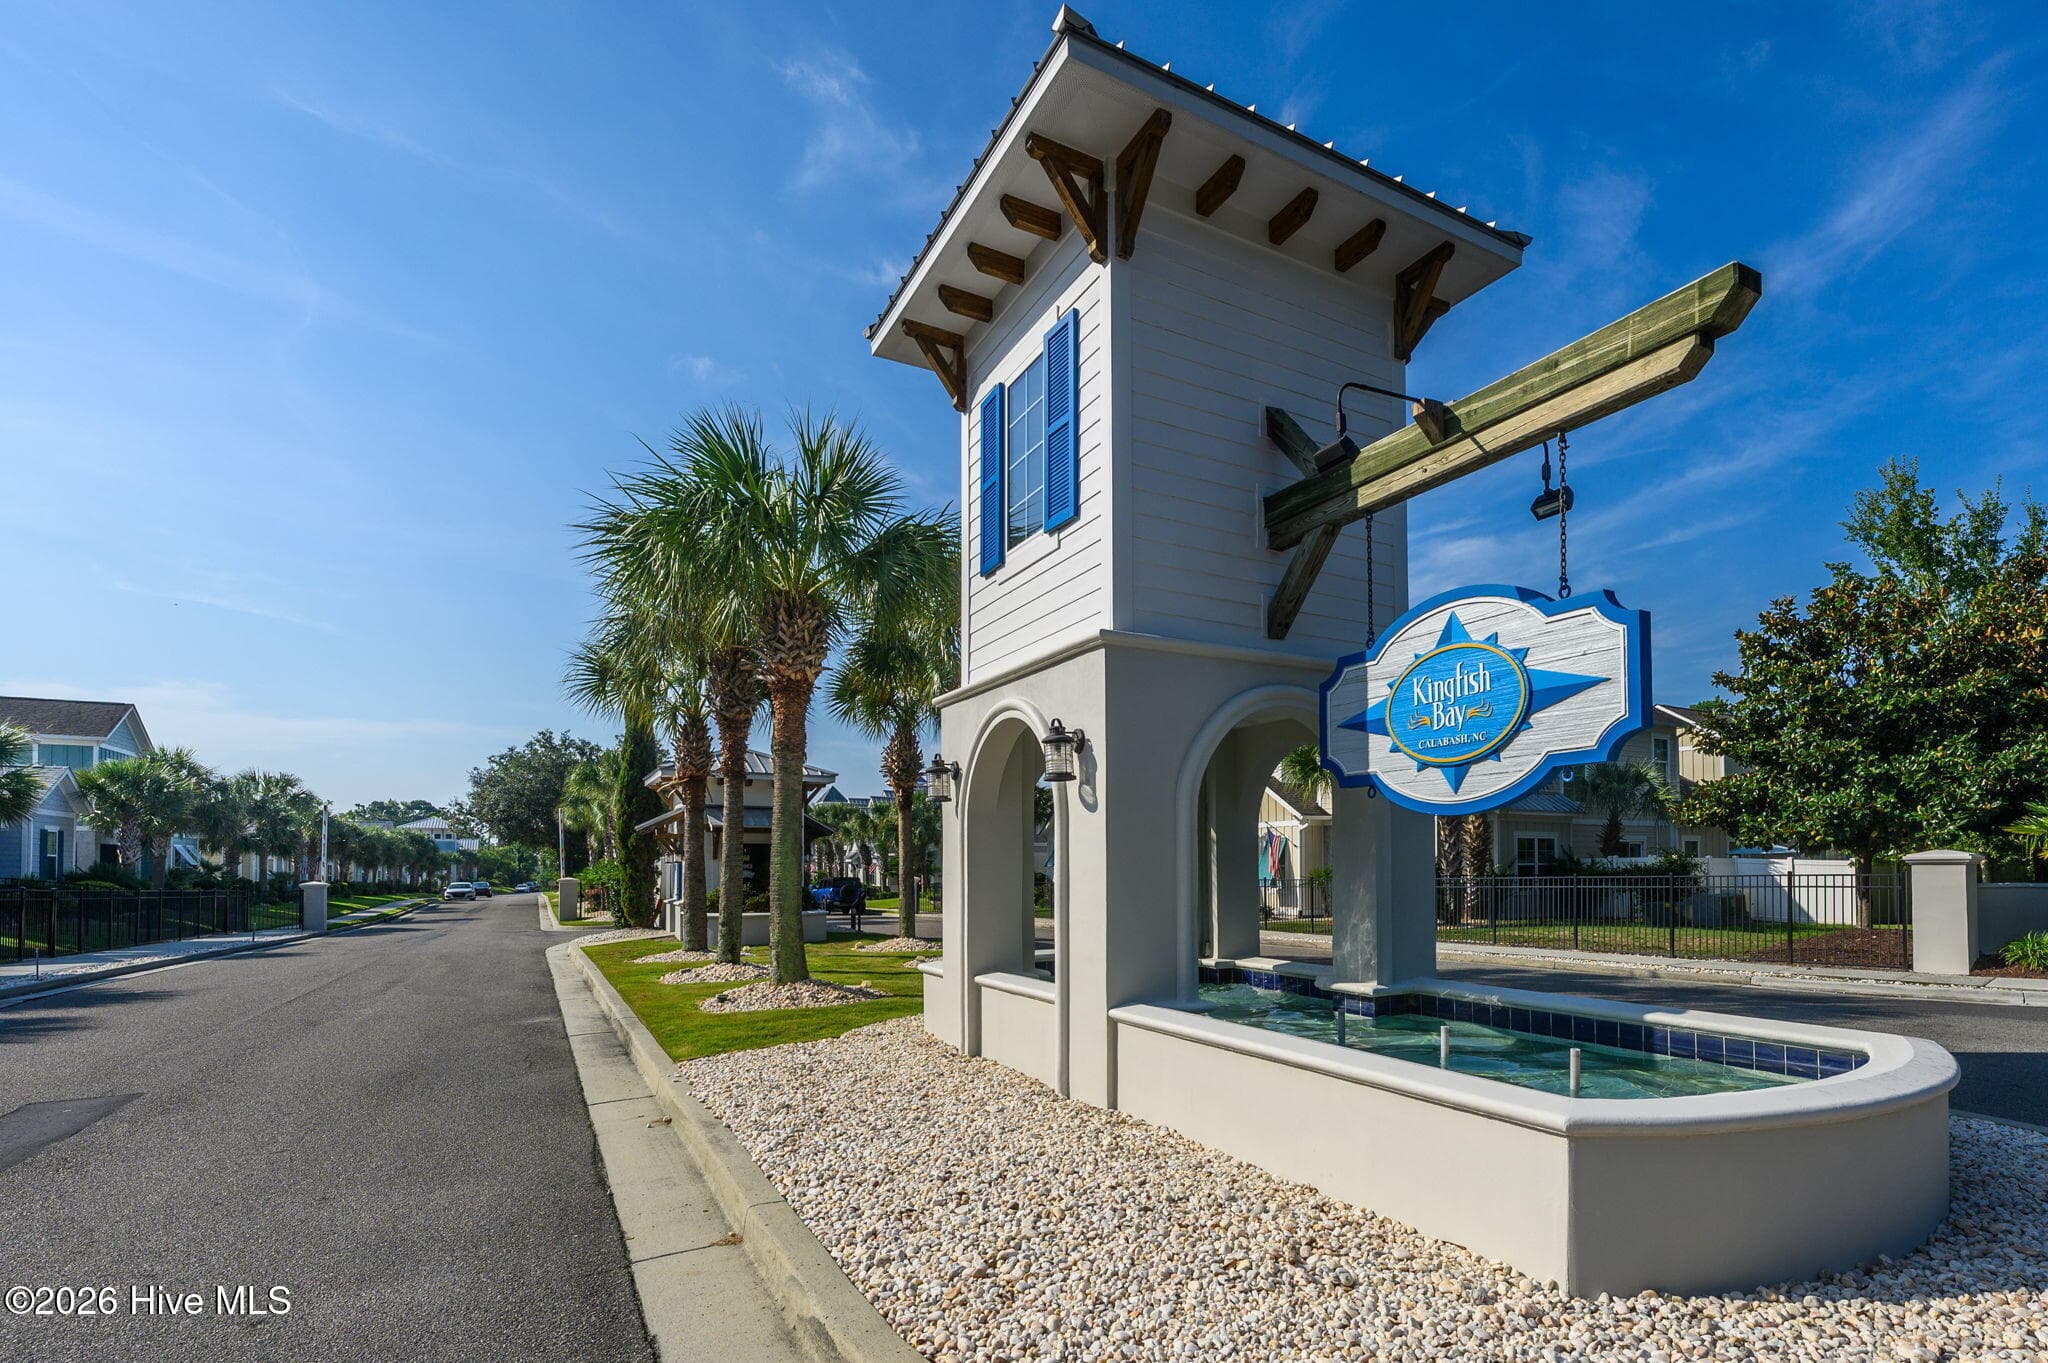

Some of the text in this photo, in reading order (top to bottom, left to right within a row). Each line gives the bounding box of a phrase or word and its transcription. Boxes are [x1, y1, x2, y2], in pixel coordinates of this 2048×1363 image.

[1413, 662, 1491, 706] Kingfish
[1432, 702, 1468, 731] Bay
[1418, 731, 1487, 749] CALABASH, NC
